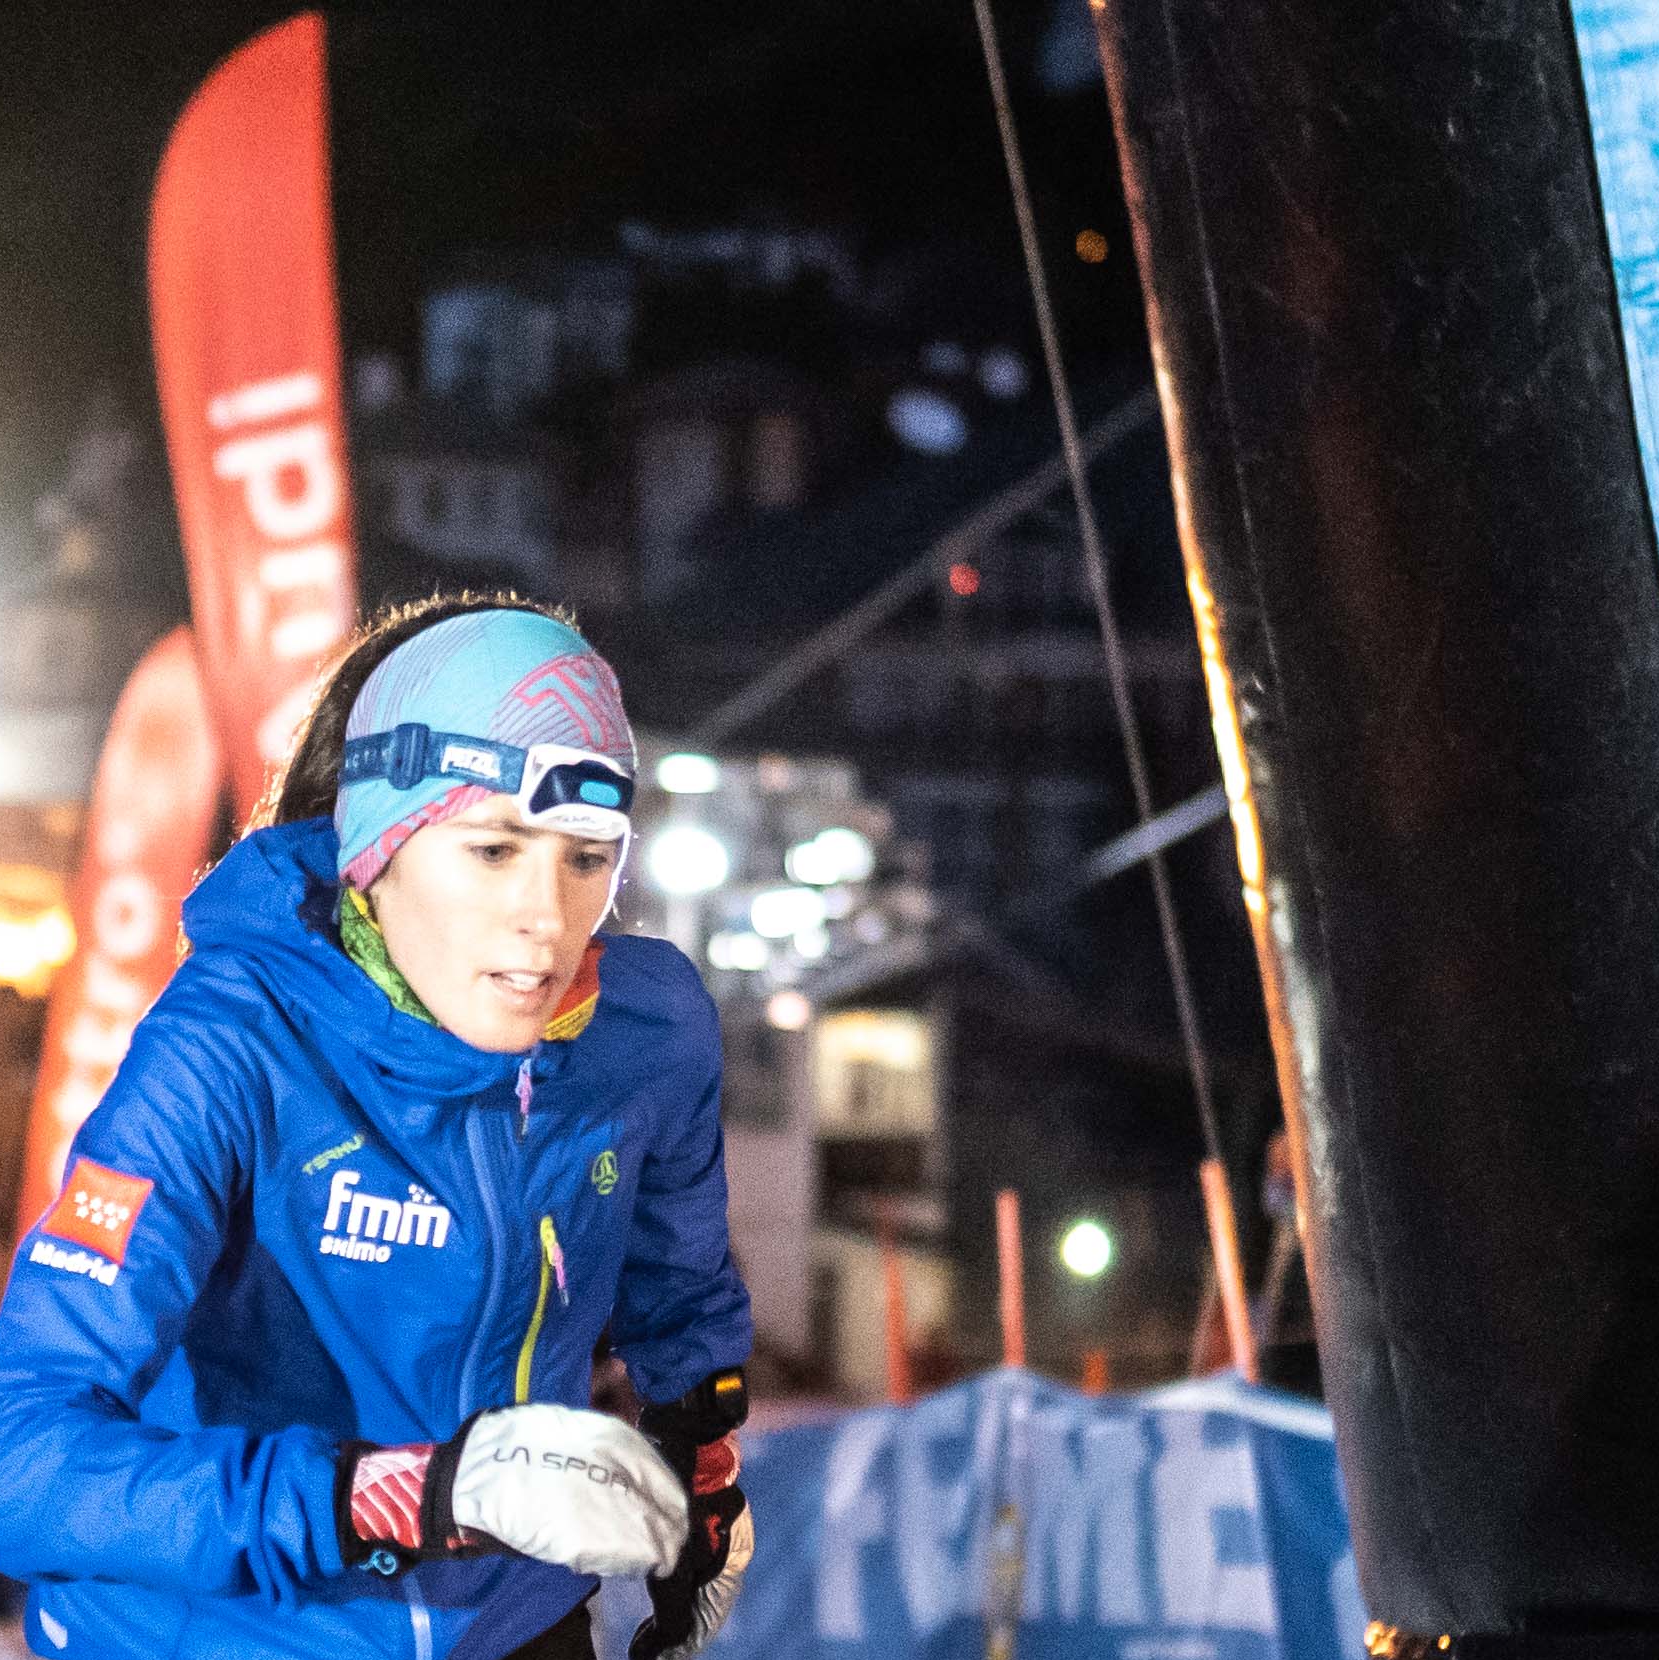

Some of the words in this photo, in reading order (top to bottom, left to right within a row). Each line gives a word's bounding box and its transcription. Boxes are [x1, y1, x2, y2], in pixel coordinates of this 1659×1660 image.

[323, 1169, 451, 1249] fmm
[29, 1240, 119, 1287] Madrid
[493, 1446, 531, 1466] LA
